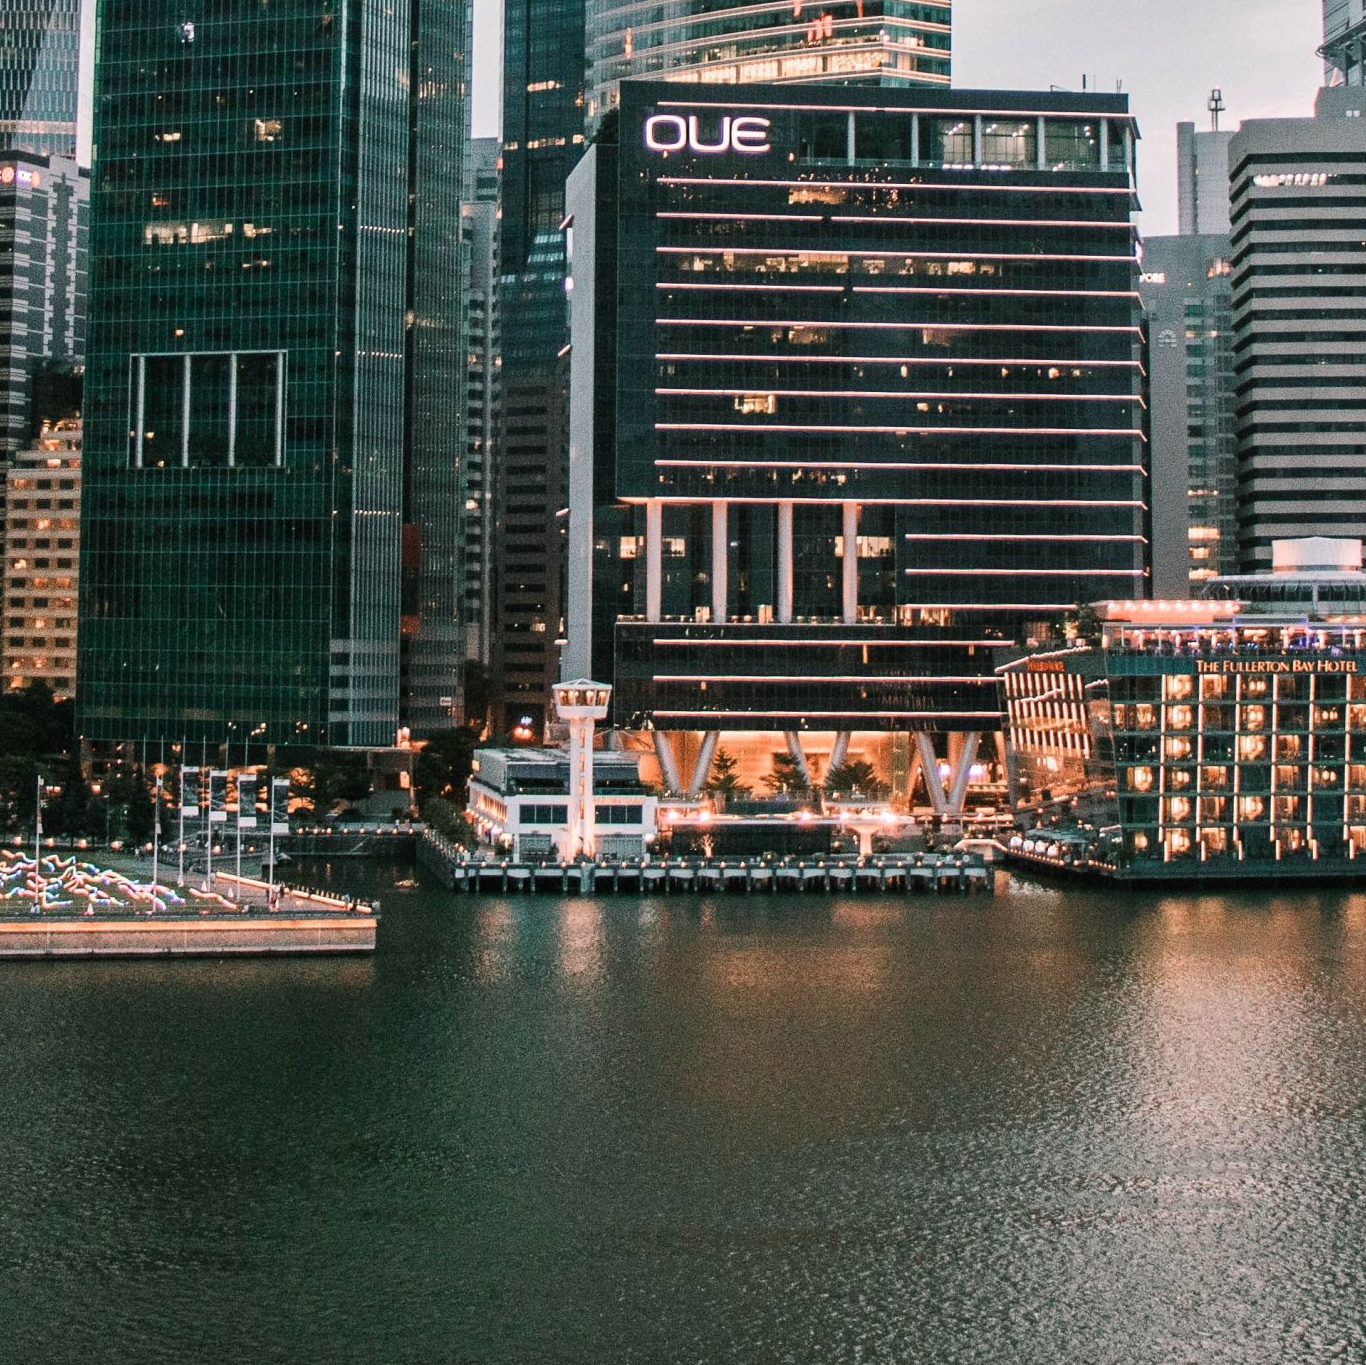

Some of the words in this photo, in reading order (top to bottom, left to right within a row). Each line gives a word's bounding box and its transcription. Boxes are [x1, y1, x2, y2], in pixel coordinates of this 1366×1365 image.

[645, 114, 772, 152] OUE
[1196, 659, 1220, 673] THE
[1223, 659, 1292, 673] FULLERTON
[1292, 659, 1316, 673] BAY
[1317, 659, 1358, 673] HOTEL
